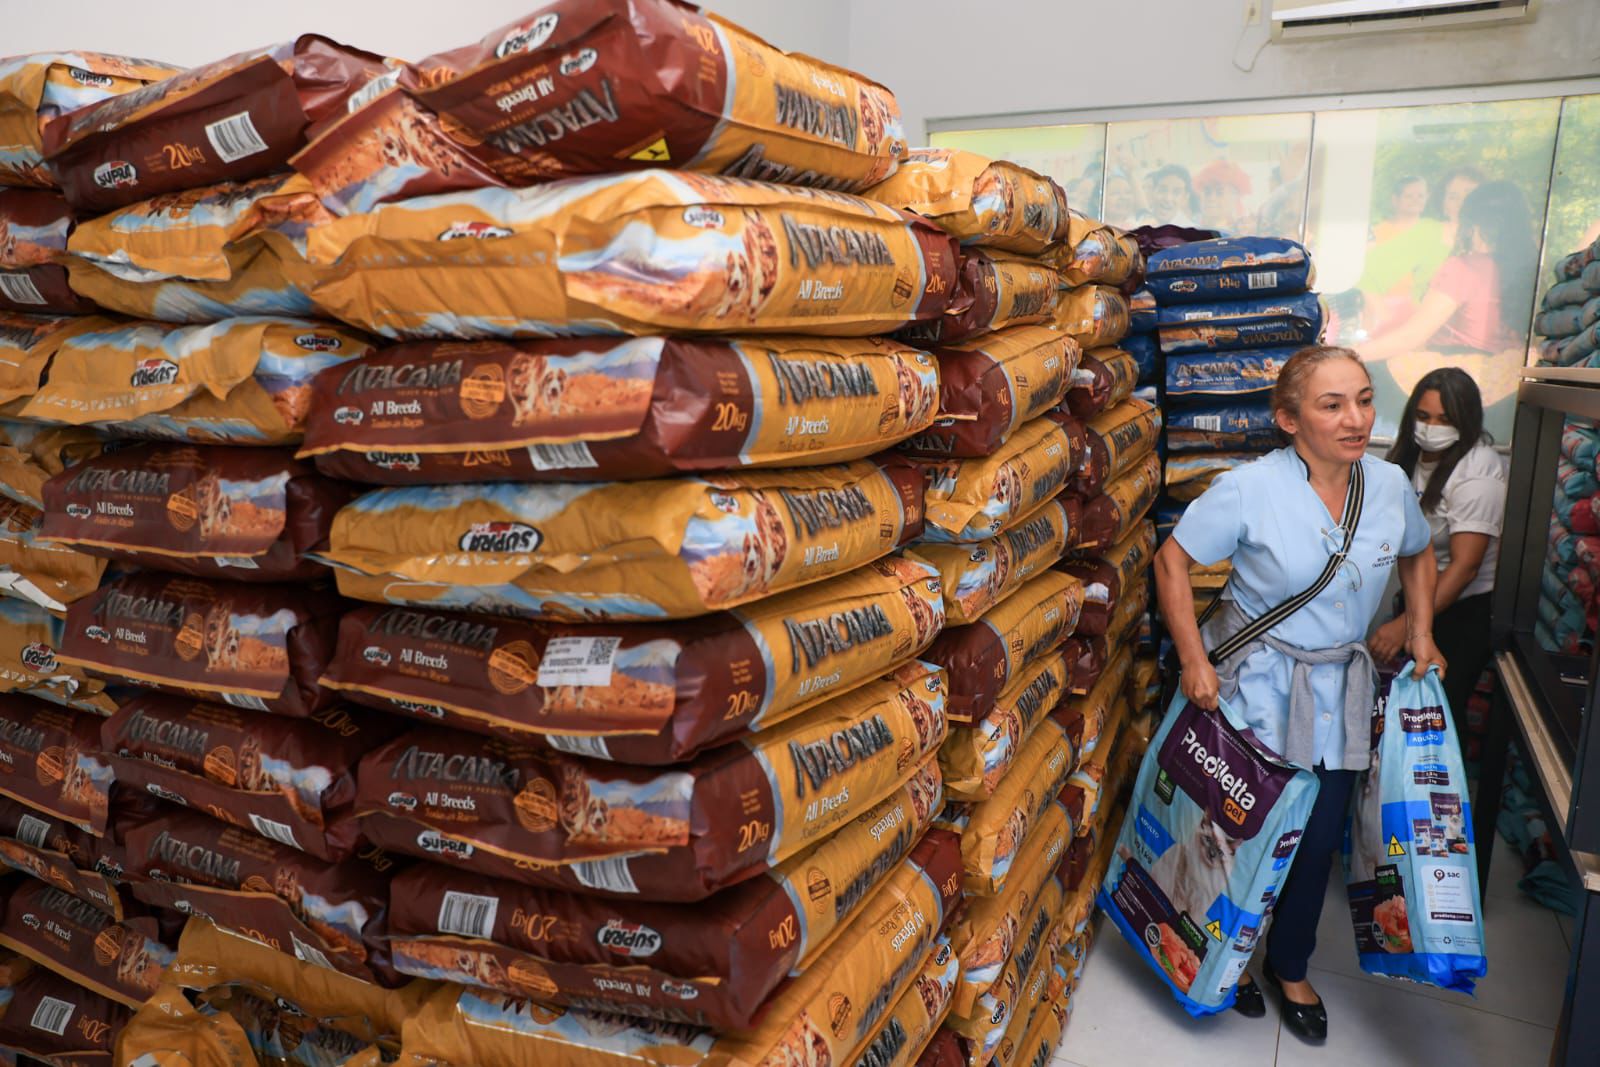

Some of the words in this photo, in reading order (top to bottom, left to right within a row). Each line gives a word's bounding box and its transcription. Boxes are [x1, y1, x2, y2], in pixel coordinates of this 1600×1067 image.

[503, 17, 553, 55] SUPRA
[497, 84, 539, 113] Breeds
[536, 76, 555, 97] All
[162, 143, 206, 171] 20kg
[97, 163, 133, 186] SUPRA
[781, 212, 896, 271] ATACAMA
[1159, 255, 1219, 271] ATACAMA
[798, 279, 811, 300] All
[1171, 281, 1198, 291] SUPRA
[299, 336, 336, 350] SUPRA
[337, 360, 463, 395] ATACAMA
[769, 352, 880, 406] ATACAMA
[1176, 362, 1239, 378] ATACAMA
[371, 401, 384, 416] All
[386, 399, 422, 416] Breeds
[712, 401, 748, 432] 20kg
[66, 466, 171, 494] ATACAMA
[97, 502, 107, 514] All
[108, 502, 134, 517] Breeds
[779, 486, 876, 542] ATACAMA
[470, 528, 534, 552] SUPRA
[805, 548, 815, 567] All
[94, 588, 185, 627] ATACAMA
[114, 627, 125, 639] All
[125, 629, 147, 644] Breeds
[369, 608, 499, 649] ATACAMA
[783, 604, 894, 675] ATACAMA
[365, 648, 391, 661] SUPRA
[400, 648, 412, 664] All
[415, 651, 449, 671] Breeds
[723, 690, 760, 721] 20kg
[120, 708, 209, 754] ATACAMA
[1412, 734, 1439, 743] ADULTO
[391, 745, 521, 788] ATACAMA
[789, 715, 894, 798] ATACAMA
[424, 792, 437, 806] All
[441, 794, 475, 810] Breeds
[805, 802, 818, 823] All
[820, 788, 849, 816] Breeds
[892, 805, 905, 822] All
[1225, 803, 1244, 821] pet
[737, 820, 770, 853] 20kg
[870, 815, 895, 841] Breeds
[150, 831, 241, 883] ATACAMA
[421, 836, 467, 853] SUPRA
[942, 872, 959, 898] 20kg
[512, 908, 557, 942] 20kg
[768, 915, 797, 950] 20kg
[913, 910, 925, 929] All
[602, 929, 658, 949] SUPRA
[892, 920, 917, 952] Breeds
[593, 977, 633, 995] Breeds
[637, 984, 651, 997] All
[78, 1014, 111, 1043] 20kg
